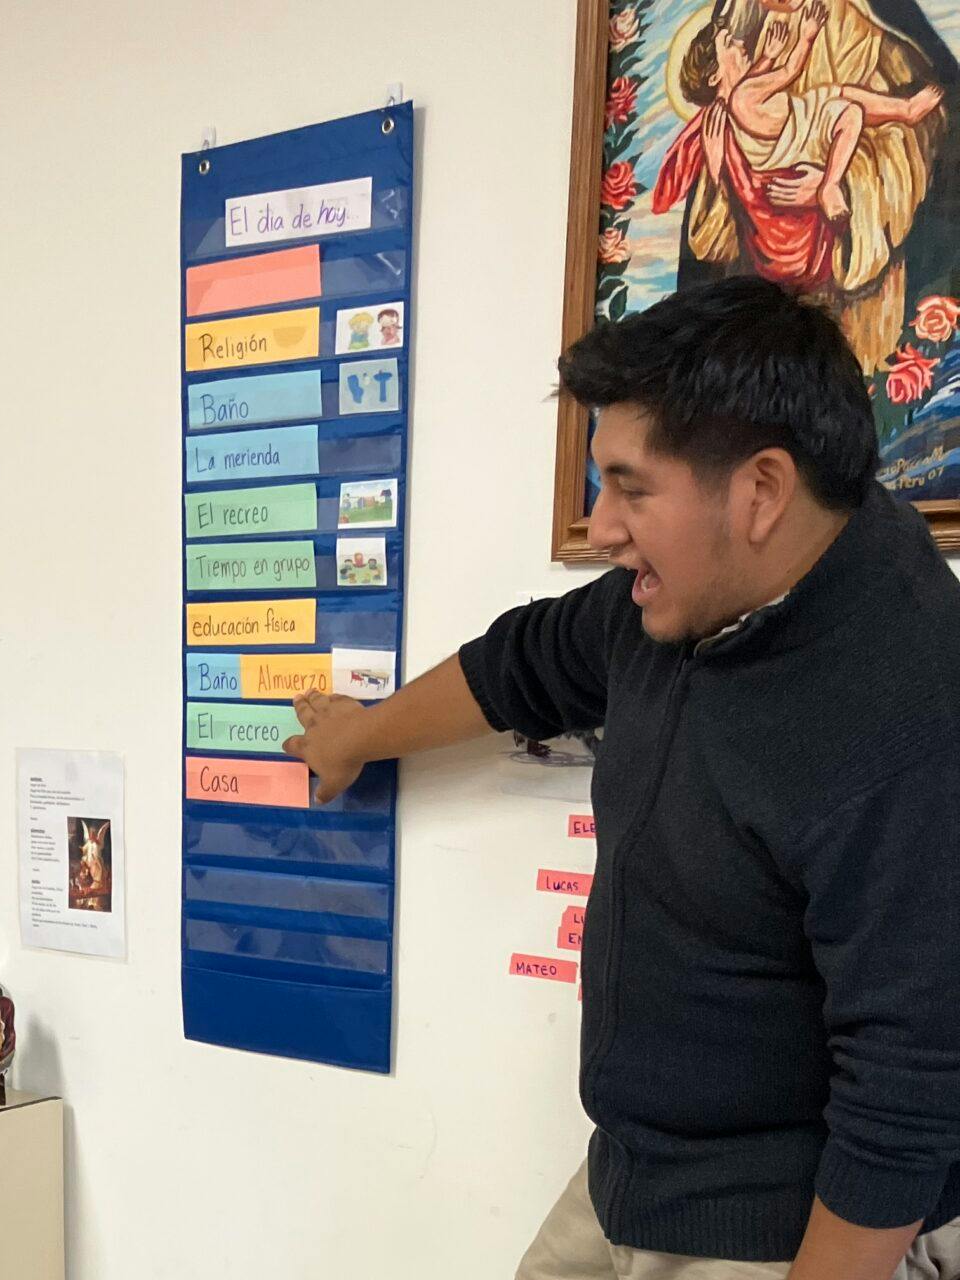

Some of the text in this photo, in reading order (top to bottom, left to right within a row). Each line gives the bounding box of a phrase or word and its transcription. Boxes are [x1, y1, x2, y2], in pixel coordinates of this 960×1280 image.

[230, 206, 248, 236] El
[291, 204, 312, 229] de
[199, 333, 268, 363] Religión
[201, 394, 249, 425] Baño
[195, 443, 281, 473] La merienda
[197, 503, 269, 529] El recreo
[195, 555, 311, 583] Tiempo en grupo
[192, 608, 296, 637] educación física
[198, 663, 327, 692] Baño Almuerzo
[197, 713, 279, 741] El recreo
[200, 766, 239, 794] Casa
[546, 876, 579, 891] LUCAS
[516, 962, 557, 976] MATEO
